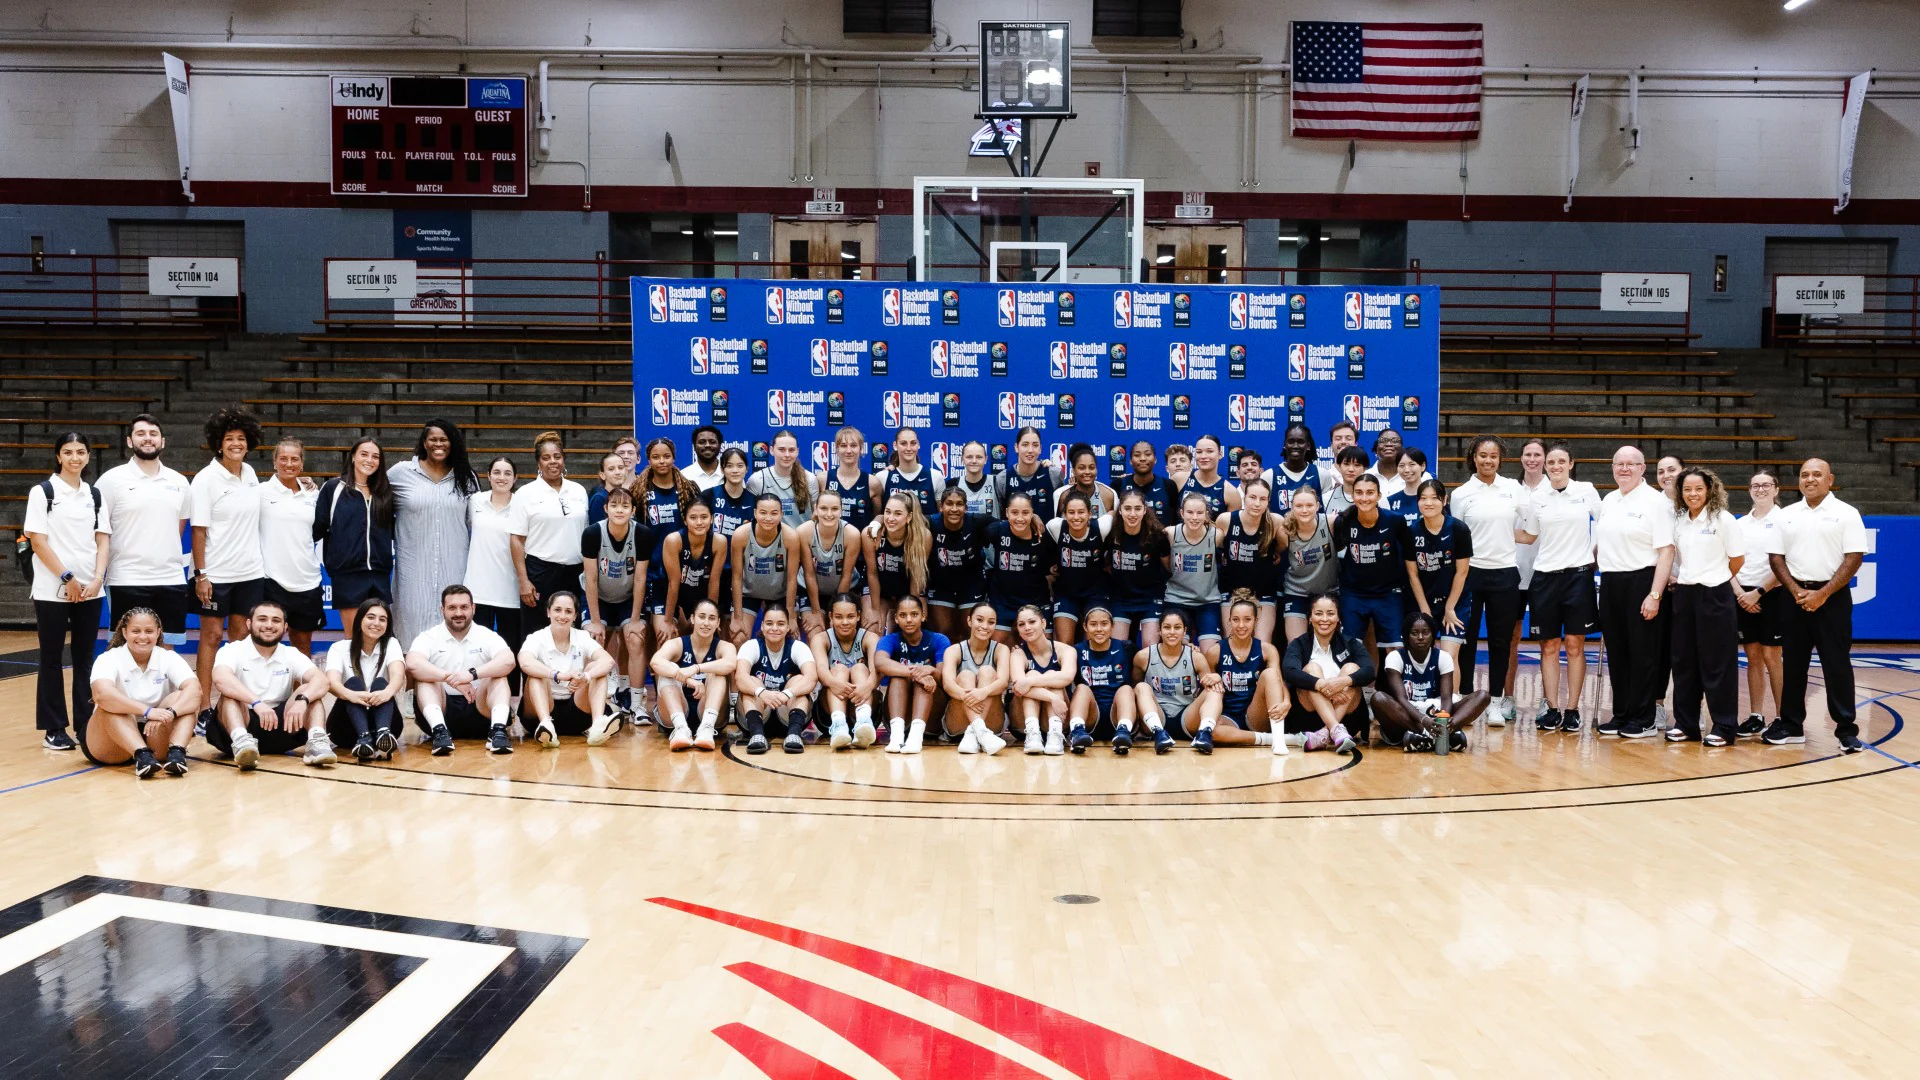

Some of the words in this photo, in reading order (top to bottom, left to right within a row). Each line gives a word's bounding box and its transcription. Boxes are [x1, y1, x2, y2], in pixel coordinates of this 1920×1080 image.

[340, 82, 384, 100] UIndy
[481, 88, 510, 100] AQUAFINA
[347, 109, 380, 120] HOME
[415, 116, 442, 125] PERIOD
[475, 110, 512, 122] GUEST
[342, 151, 366, 159] FOULS
[375, 152, 396, 160] T.O.L.
[405, 152, 434, 160] PLAYER
[436, 152, 455, 160] FOUL
[464, 153, 484, 161] T.O.L.
[492, 153, 516, 161] FOULS
[342, 184, 367, 192] SCORE
[1186, 192, 1202, 204] EXIT
[835, 204, 840, 212] 2
[1204, 208, 1210, 216] 2
[168, 272, 201, 282] SECTION
[205, 272, 218, 282] 104
[347, 274, 379, 284] SECTION
[384, 275, 397, 284] 105
[669, 286, 706, 298] Basketball
[786, 288, 823, 300] Basketball
[902, 289, 938, 302] Basketball
[1018, 291, 1054, 302] Basketball
[1134, 291, 1170, 304] Basketball
[1620, 287, 1653, 297] SECTION
[1656, 288, 1670, 298] 105
[1796, 290, 1829, 300] SECTION
[1832, 290, 1845, 300] 106
[410, 300, 457, 309] GREYHOUNDS
[669, 298, 696, 310] Without
[1249, 293, 1286, 306] Basketball
[1364, 293, 1400, 306] Basketball
[786, 300, 813, 312] Without
[902, 302, 929, 314] Without
[1018, 302, 1044, 316] Without
[1133, 304, 1160, 316] Without
[1249, 306, 1276, 318] Without
[1364, 306, 1390, 318] Without
[670, 310, 698, 322] Borders
[786, 312, 814, 324] Borders
[903, 314, 930, 325] Borders
[1018, 316, 1046, 326] Borders
[1134, 316, 1161, 327] Borders
[1249, 318, 1277, 329] Borders
[1364, 318, 1391, 329] Borders
[711, 338, 747, 350] Basketball
[831, 340, 867, 352] Basketball
[951, 341, 987, 354] Basketball
[1070, 342, 1106, 354] Basketball
[1189, 344, 1225, 356] Basketball
[711, 350, 737, 362] Without
[1308, 345, 1344, 356] Basketball
[831, 352, 857, 364] Without
[950, 354, 977, 366] Without
[1070, 354, 1096, 366] Without
[1189, 356, 1216, 368] Without
[1308, 356, 1334, 368] Without
[711, 362, 739, 374] Borders
[831, 364, 859, 376] Borders
[951, 366, 978, 377] Borders
[1070, 366, 1098, 378] Borders
[1189, 368, 1216, 379] Borders
[1308, 368, 1335, 380] Borders
[671, 389, 708, 402] Basketball
[787, 391, 823, 402] Basketball
[903, 392, 939, 404] Basketball
[1018, 393, 1054, 406] Basketball
[1133, 394, 1169, 406] Basketball
[1248, 395, 1284, 408] Basketball
[671, 402, 698, 414] Without
[787, 402, 814, 414] Without
[1363, 396, 1399, 408] Basketball
[903, 404, 929, 416] Without
[1018, 406, 1044, 418] Without
[1133, 406, 1160, 418] Without
[1248, 408, 1274, 420] Without
[1363, 408, 1389, 420] Without
[672, 414, 699, 425] Borders
[787, 414, 815, 426] Borders
[903, 416, 930, 428] Borders
[1018, 418, 1046, 430] Borders
[1133, 418, 1160, 430] Borders
[1248, 420, 1275, 431] Borders
[1363, 420, 1391, 431] Borders
[720, 440, 748, 452] sketball
[891, 474, 899, 483] 45
[1010, 477, 1018, 487] 46
[1277, 476, 1286, 485] 54
[829, 481, 838, 490] 50
[984, 485, 992, 493] 32
[715, 498, 725, 508] 39
[1232, 525, 1240, 536] 18
[1350, 528, 1358, 538] 19
[936, 534, 946, 543] 47
[1000, 536, 1010, 546] 30
[1063, 533, 1070, 543] 29
[1415, 537, 1425, 547] 23
[683, 652, 692, 663] 28
[1082, 650, 1089, 660] 31
[1223, 654, 1232, 665] 26
[1183, 660, 1187, 669] 9
